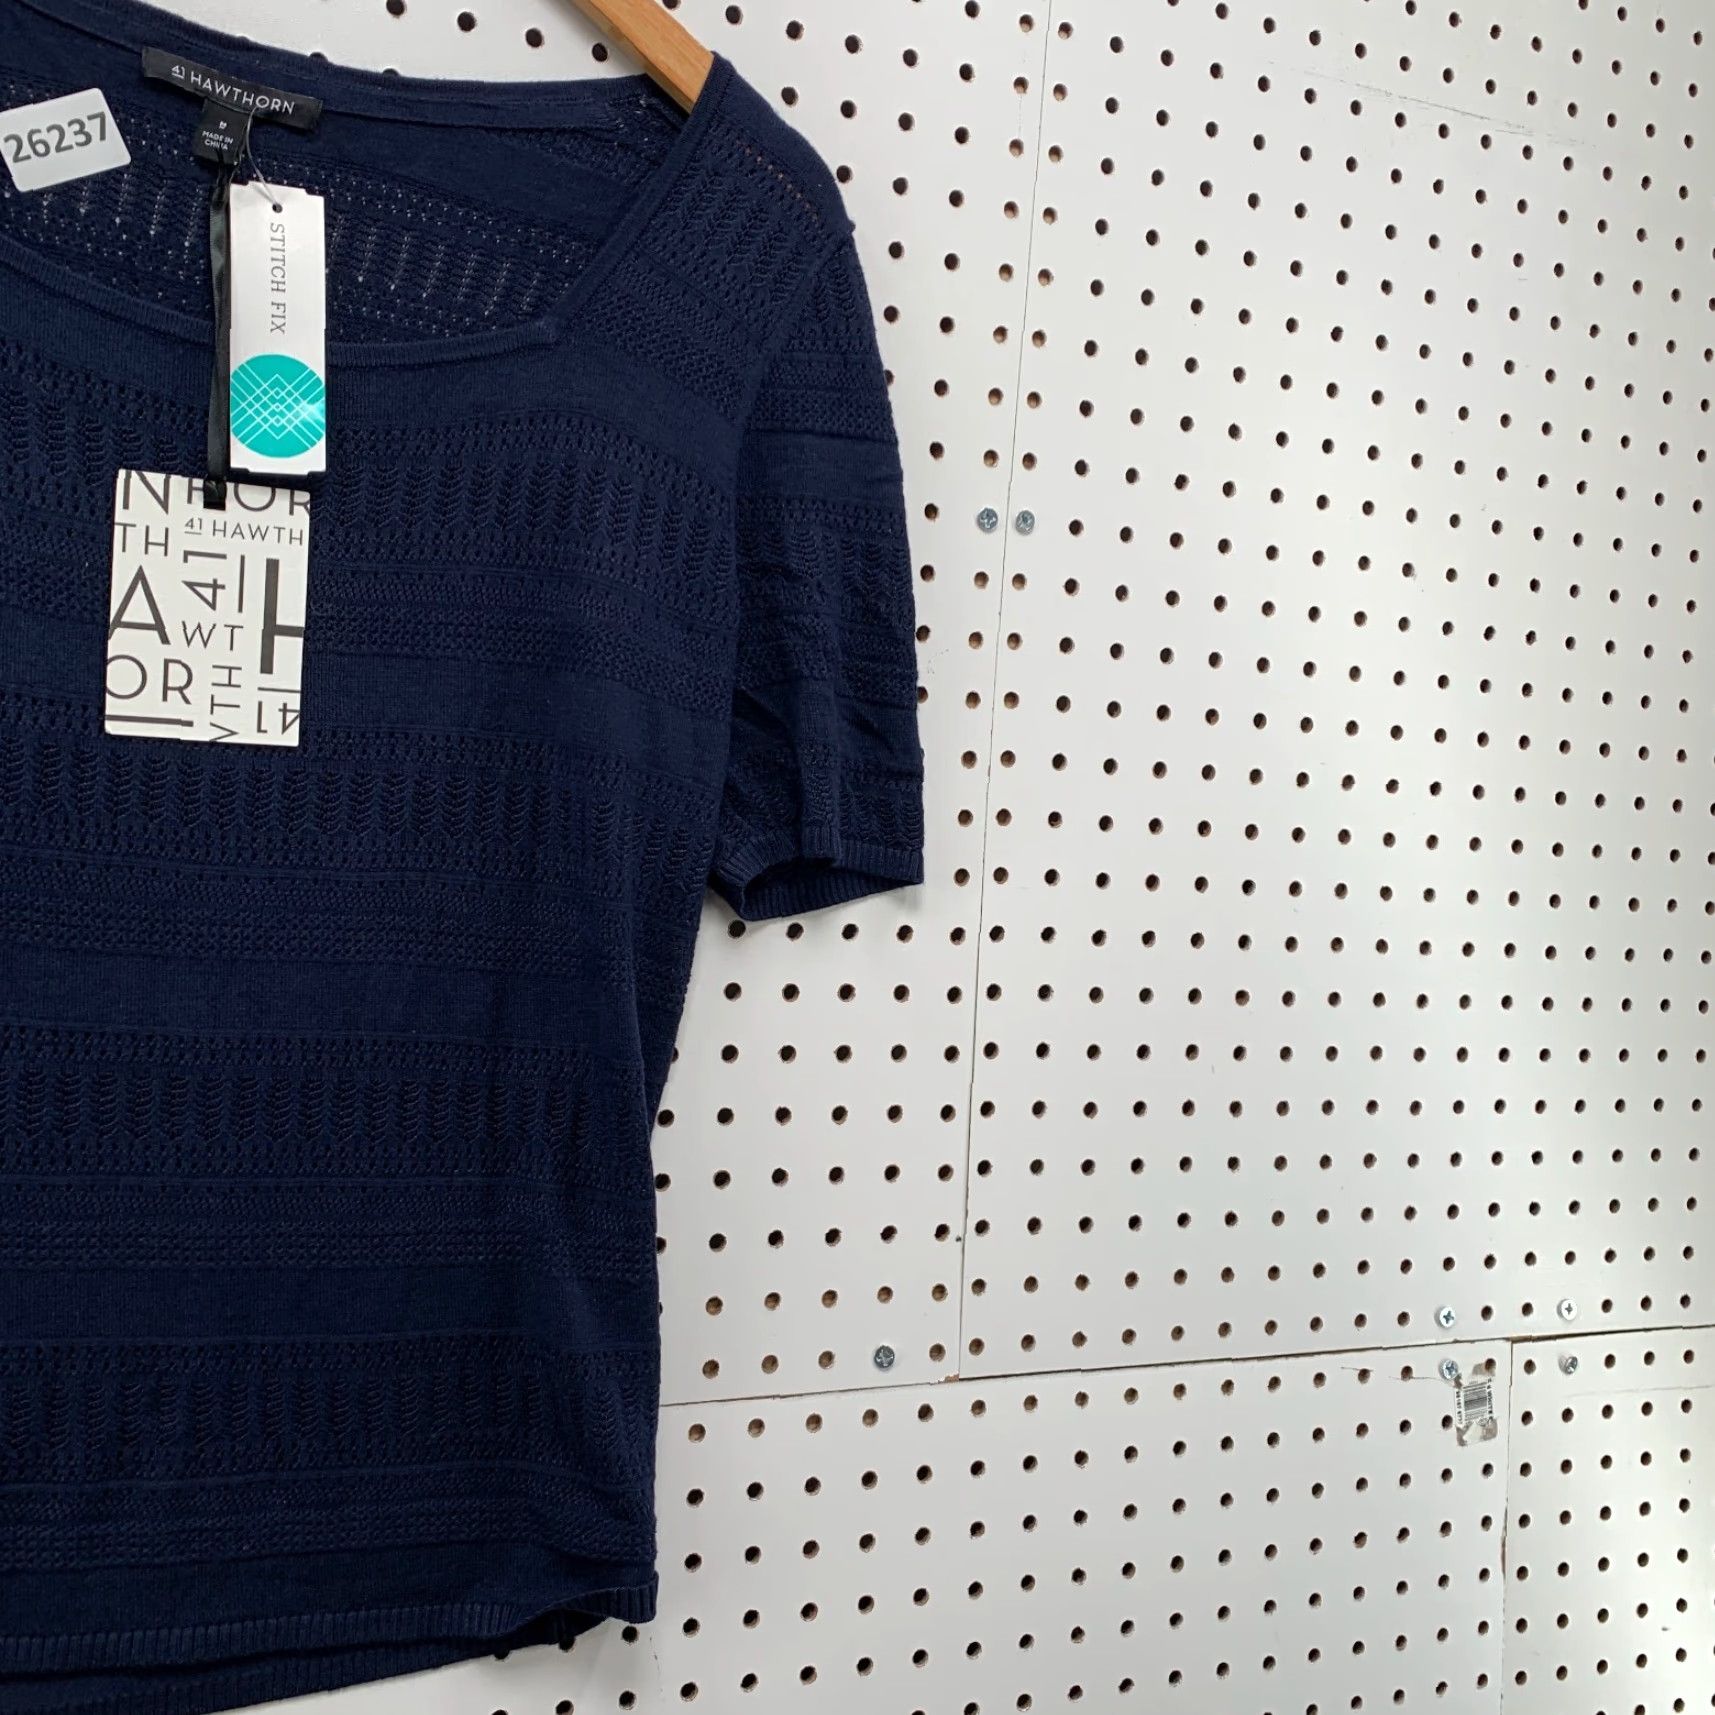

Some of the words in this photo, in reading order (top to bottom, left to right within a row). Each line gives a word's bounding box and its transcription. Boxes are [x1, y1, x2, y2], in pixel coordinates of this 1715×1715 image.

[171, 65, 185, 79] 41
[191, 71, 296, 115] HAWTHORN
[4, 111, 107, 163] 26237
[270, 222, 286, 293] STITCH
[270, 301, 286, 335] FIX
[115, 522, 169, 557] TH
[185, 518, 203, 533] 41
[212, 520, 304, 545] HAWTH
[108, 565, 171, 645] A
[182, 620, 244, 651] WT
[106, 654, 193, 705] OR
